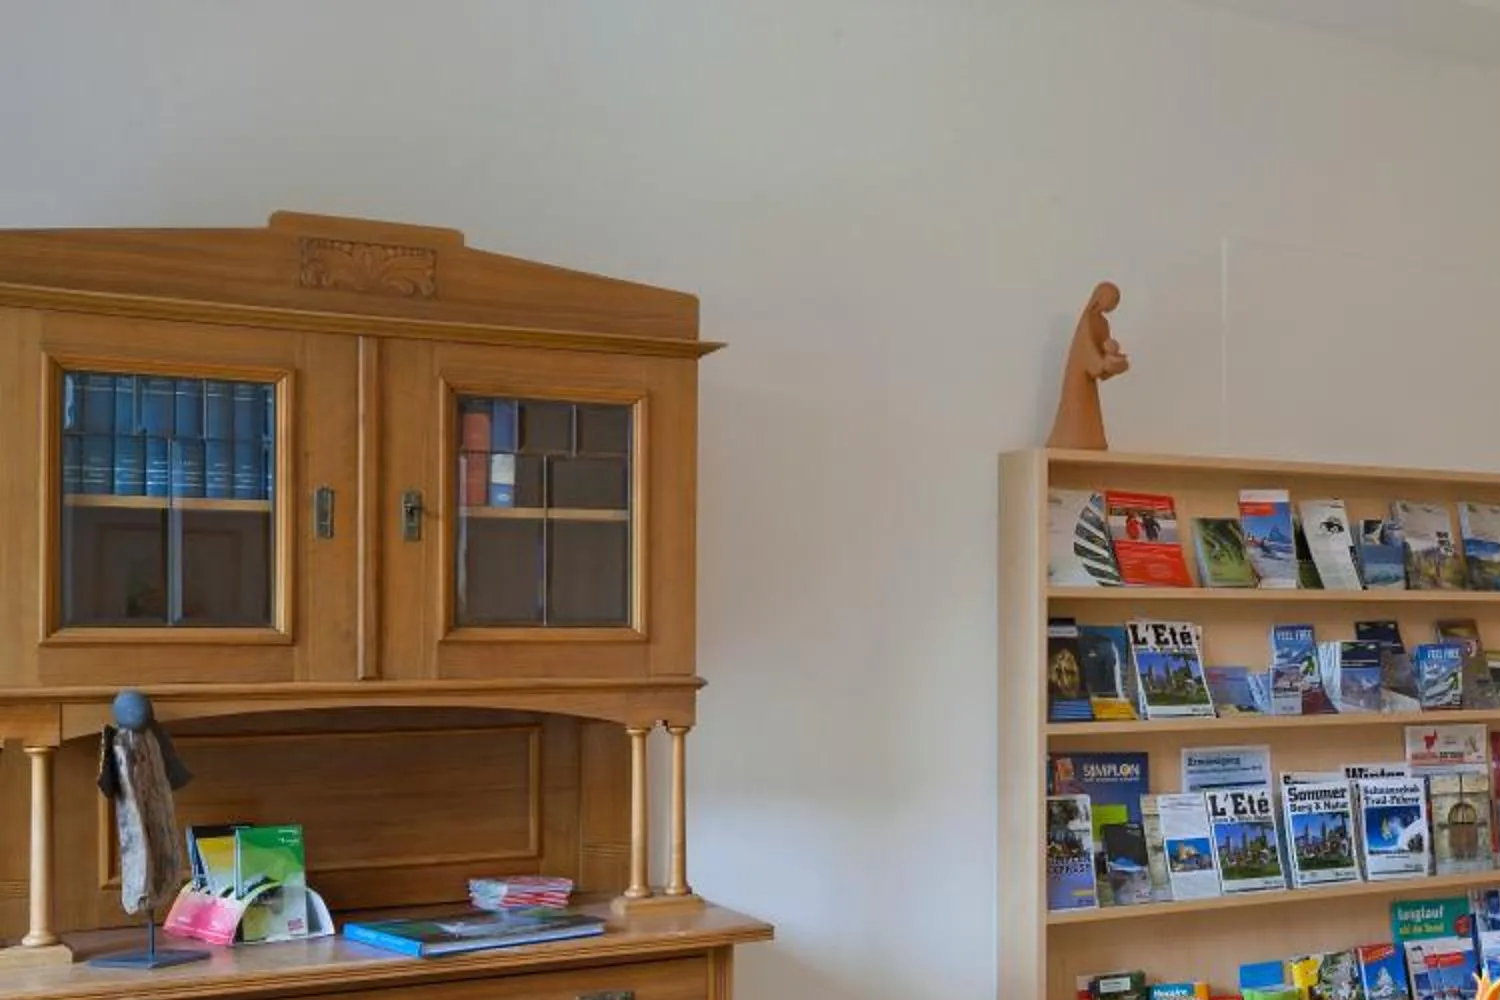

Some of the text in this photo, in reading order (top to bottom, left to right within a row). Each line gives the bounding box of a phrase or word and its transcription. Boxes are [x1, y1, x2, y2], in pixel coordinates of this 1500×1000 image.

[1129, 623, 1193, 645] L'Eté
[1208, 791, 1271, 817] L'Eté
[1287, 786, 1348, 802] Sommer
